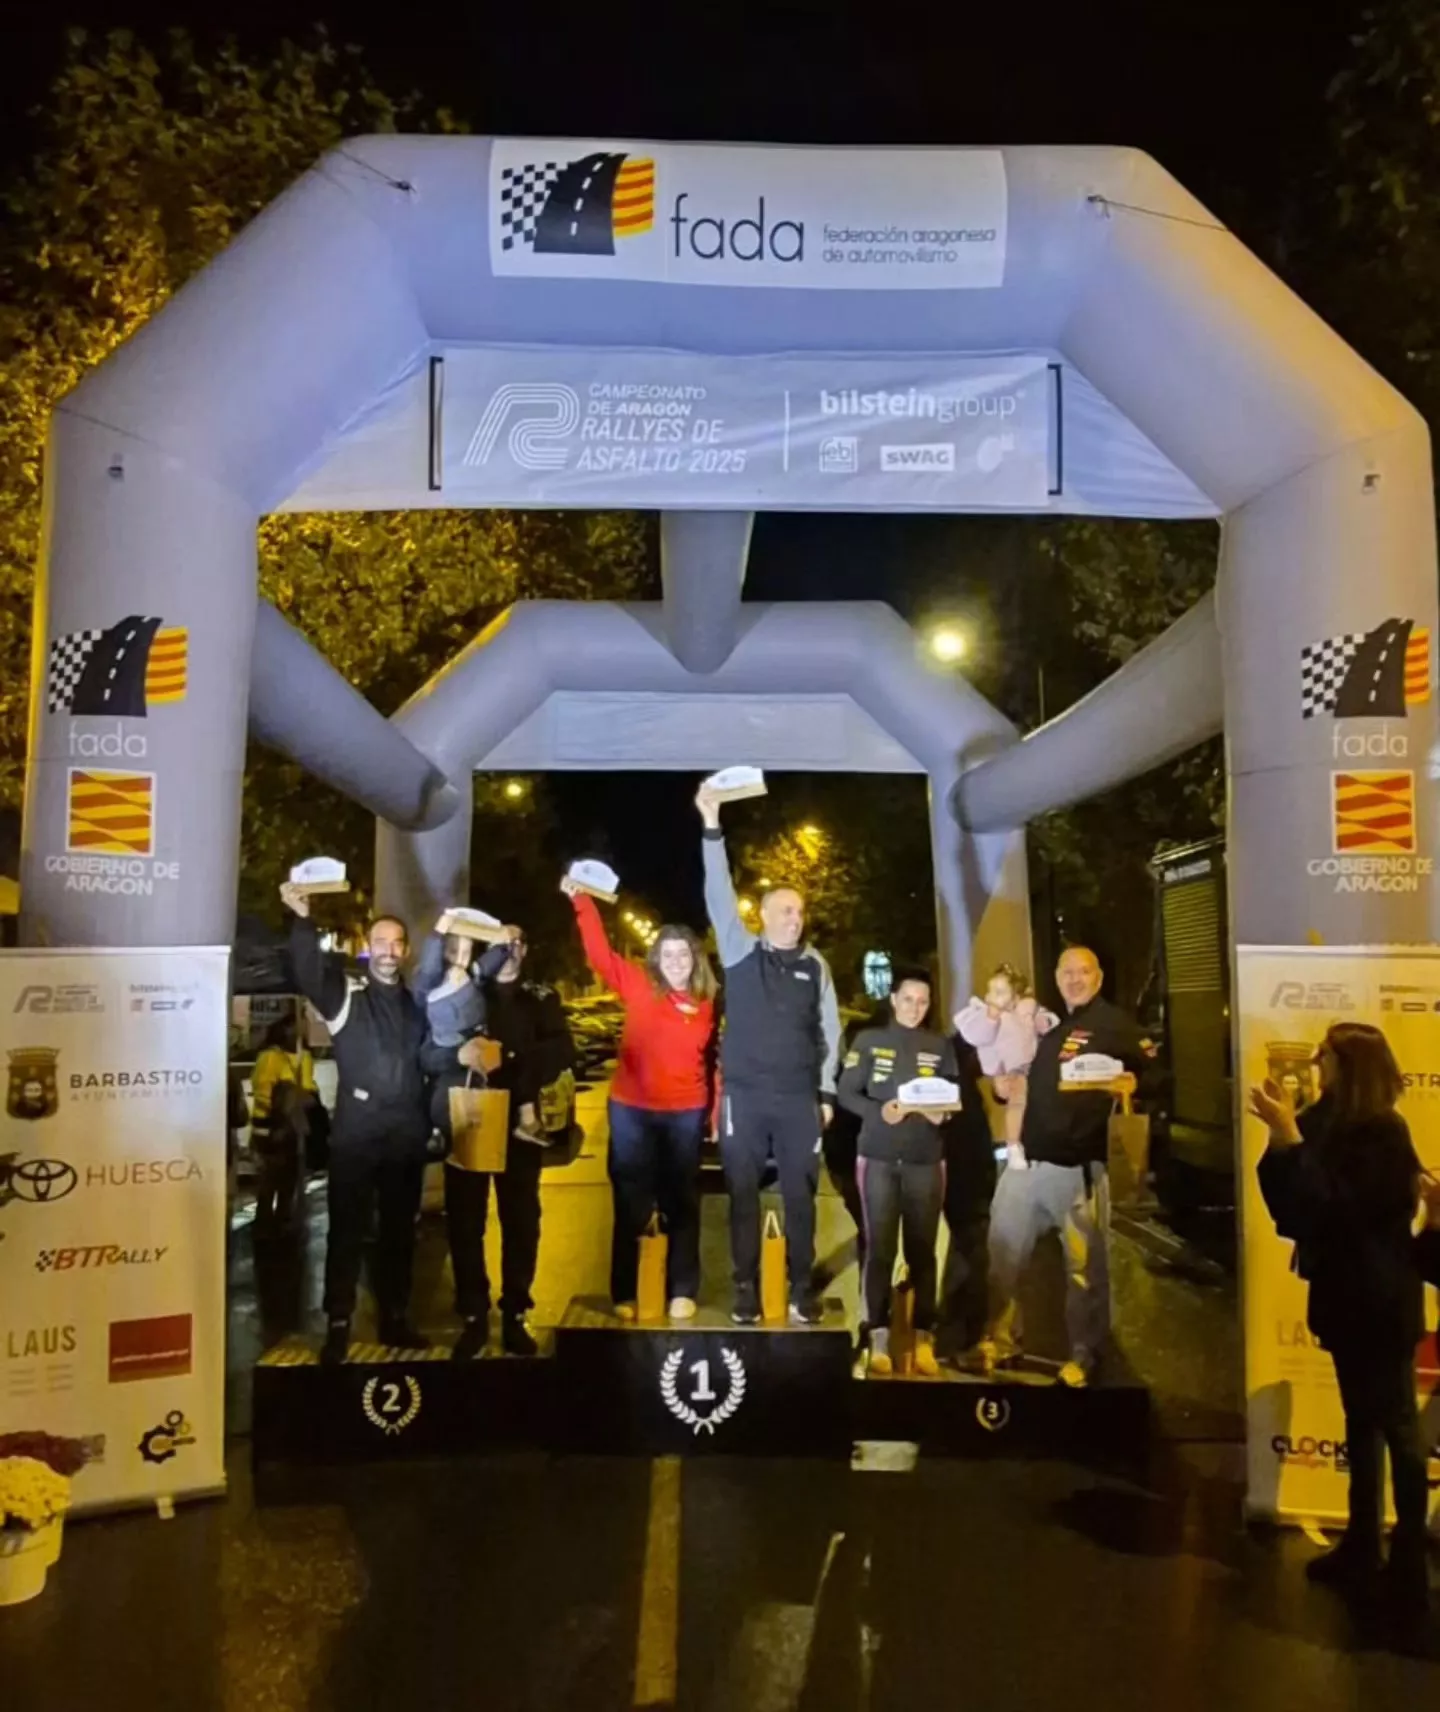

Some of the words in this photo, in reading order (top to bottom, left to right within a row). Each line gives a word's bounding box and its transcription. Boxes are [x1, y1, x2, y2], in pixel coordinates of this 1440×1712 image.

[670, 193, 804, 262] fada
[823, 223, 908, 243] federación
[912, 228, 996, 246] aragonesa
[822, 247, 844, 262] de
[848, 246, 958, 263] automovilismo
[588, 384, 707, 400] CAMPEONATO
[588, 401, 611, 415] DE
[580, 418, 684, 442] RALLYES
[691, 419, 724, 443] DE
[576, 446, 680, 471] ASFALTO
[688, 449, 747, 473] 2025
[886, 449, 950, 465] SWAG
[68, 721, 147, 758] fada
[1331, 723, 1408, 759] fada
[45, 855, 144, 877] GOBIERNO
[153, 861, 180, 880] DE
[1306, 857, 1411, 876] GOBIERNO
[1415, 858, 1433, 874] DE
[69, 1070, 203, 1089] BARBASTRO
[86, 1159, 202, 1188] HUESCA
[7, 1326, 76, 1358] LAUS
[690, 1359, 717, 1400] 1
[382, 1383, 401, 1412] 2
[987, 1401, 999, 1420] 3
